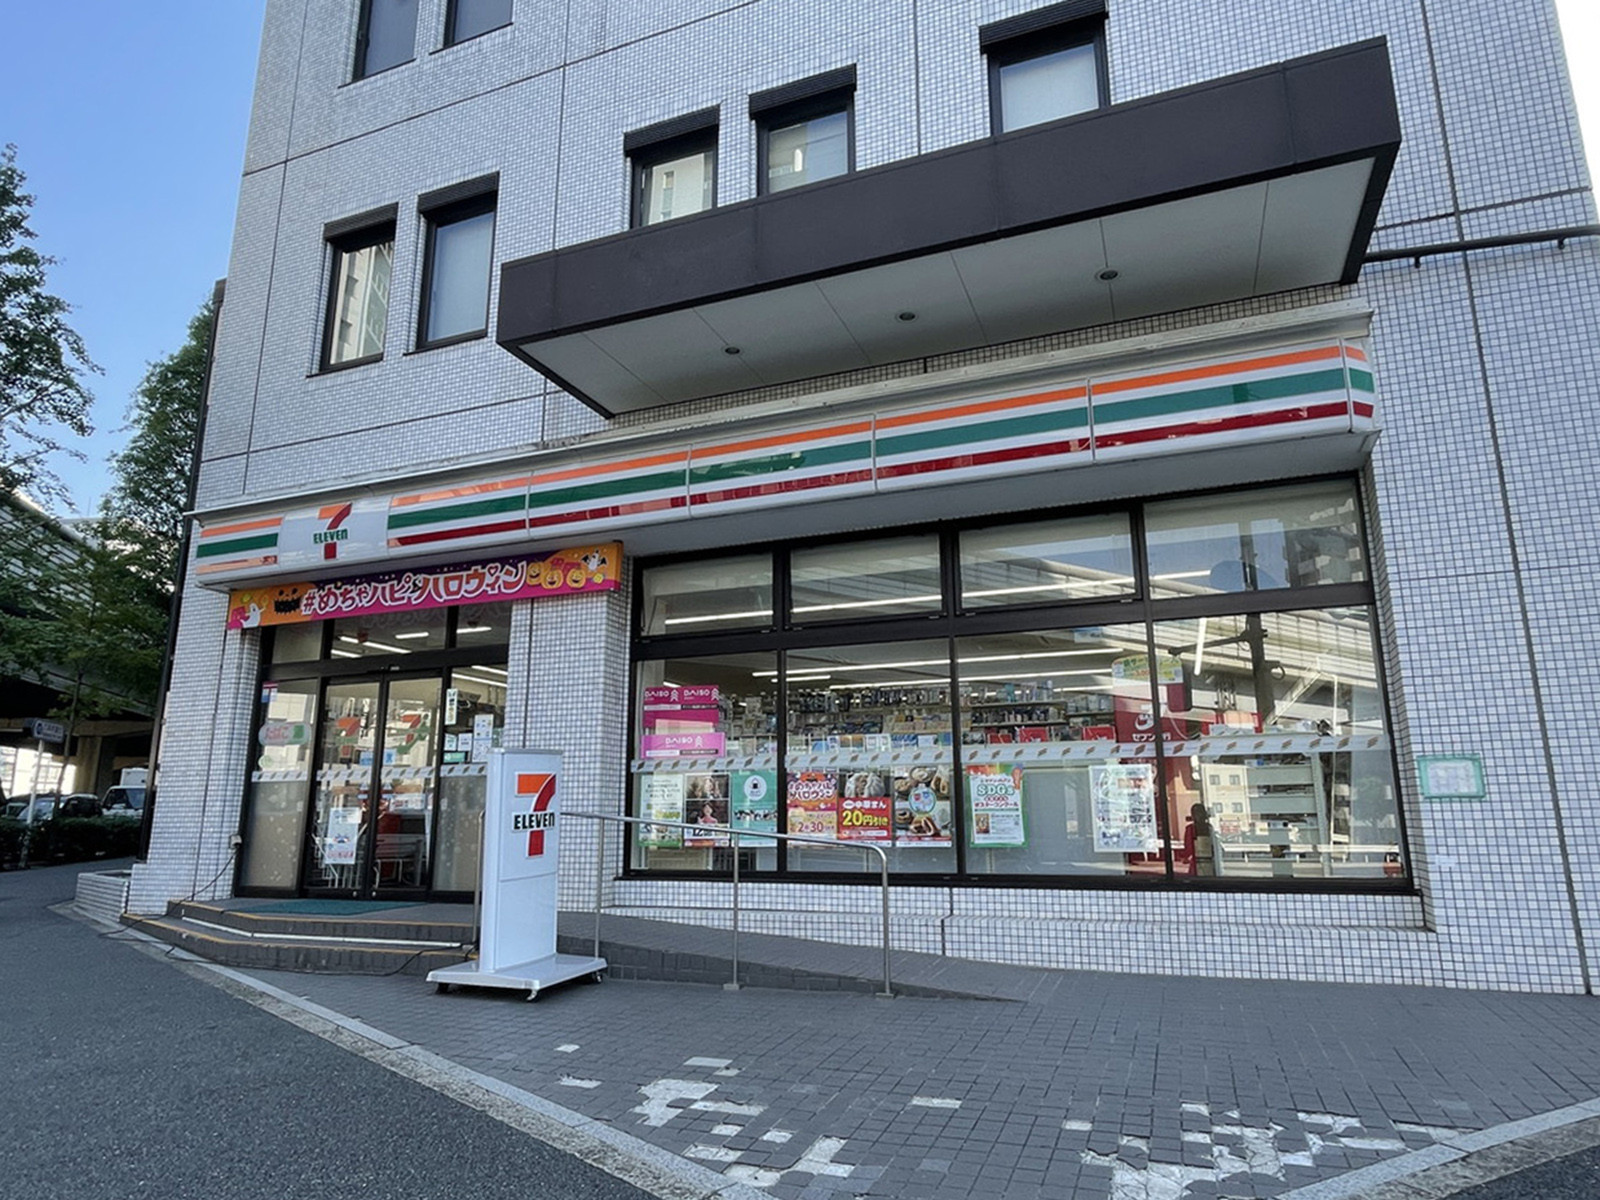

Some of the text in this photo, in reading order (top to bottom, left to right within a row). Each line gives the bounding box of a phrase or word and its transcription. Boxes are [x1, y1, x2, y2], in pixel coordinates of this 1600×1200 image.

[317, 501, 353, 560] 7
[644, 690, 670, 698] DAISO
[683, 689, 710, 697] DAISO
[665, 736, 693, 745] DAISO
[976, 783, 1015, 796] SDGs
[516, 773, 556, 857] 7
